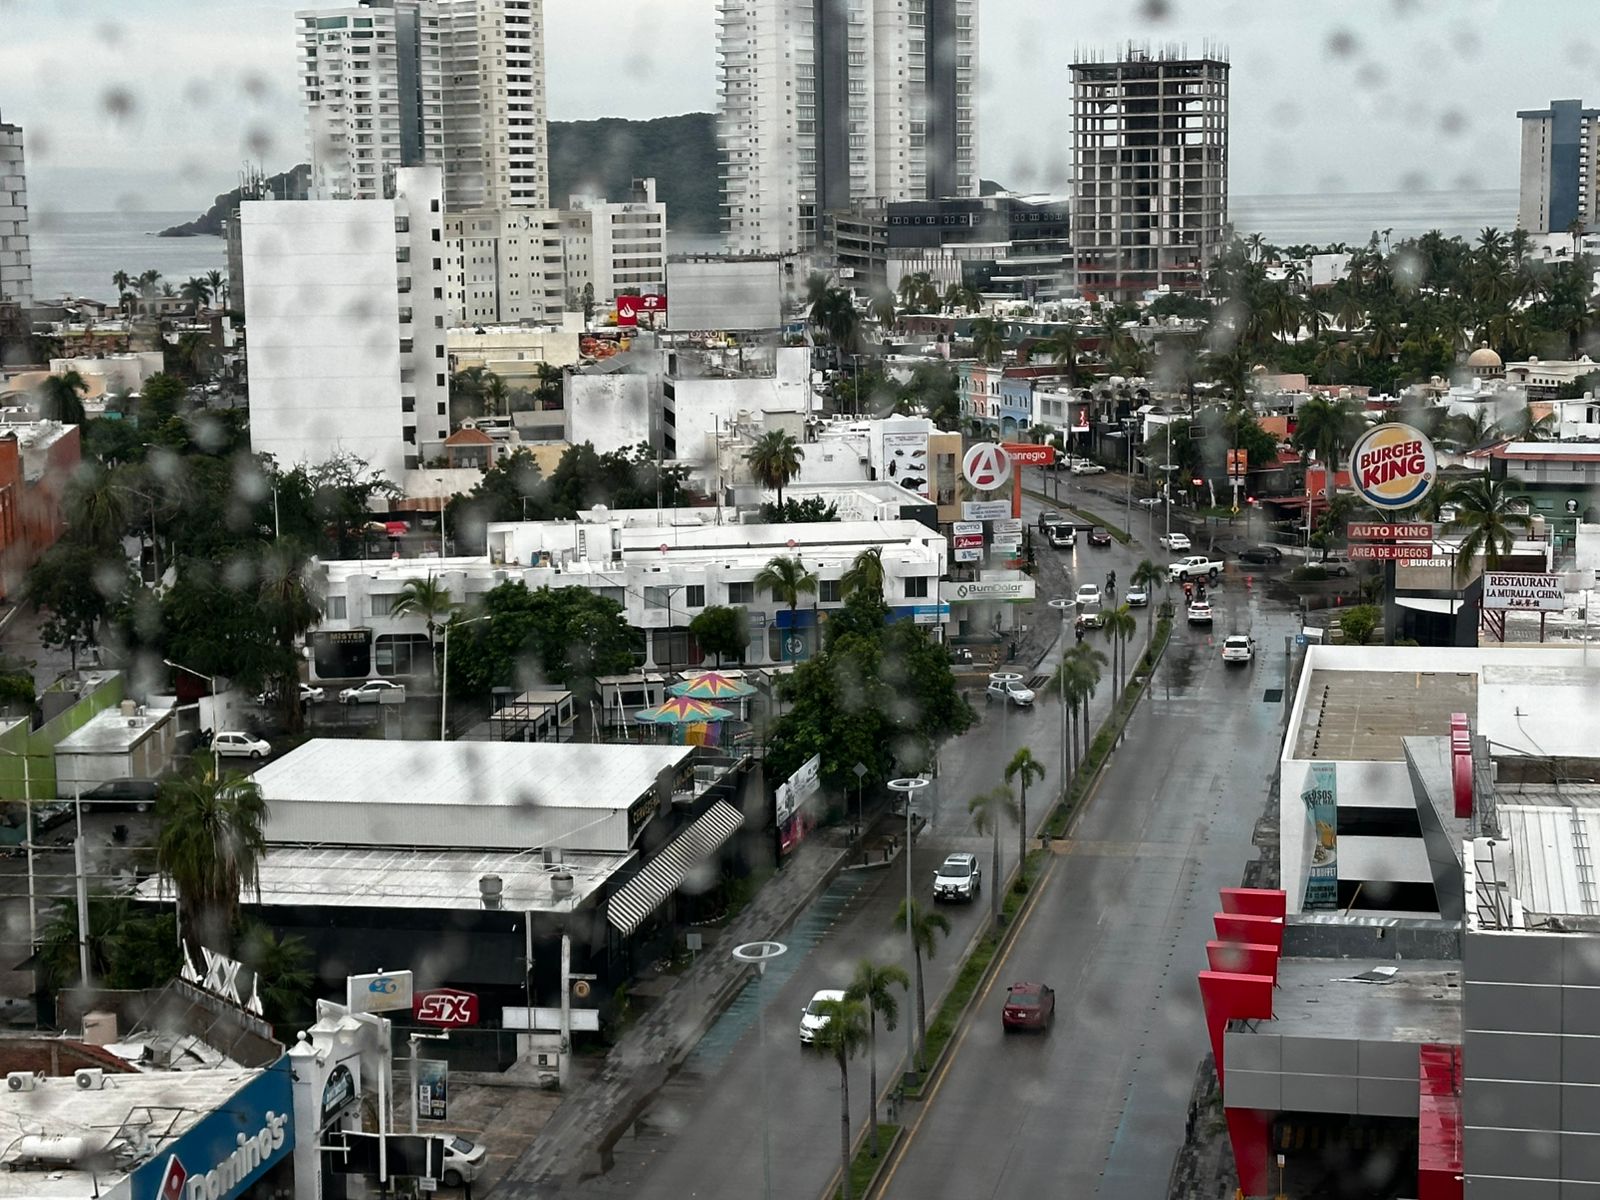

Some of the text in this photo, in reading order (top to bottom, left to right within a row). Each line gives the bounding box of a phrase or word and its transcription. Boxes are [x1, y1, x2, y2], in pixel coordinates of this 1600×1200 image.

[1361, 440, 1423, 470] BURGER
[1363, 454, 1425, 489] KING
[1352, 526, 1429, 537] AUTO KING
[1378, 547, 1390, 558] DE
[1392, 547, 1429, 559] JUEGOS
[1409, 559, 1447, 568] BURGER
[1490, 576, 1559, 588] RESTAURANT
[1486, 588, 1563, 600] LA MURALLA CHINA
